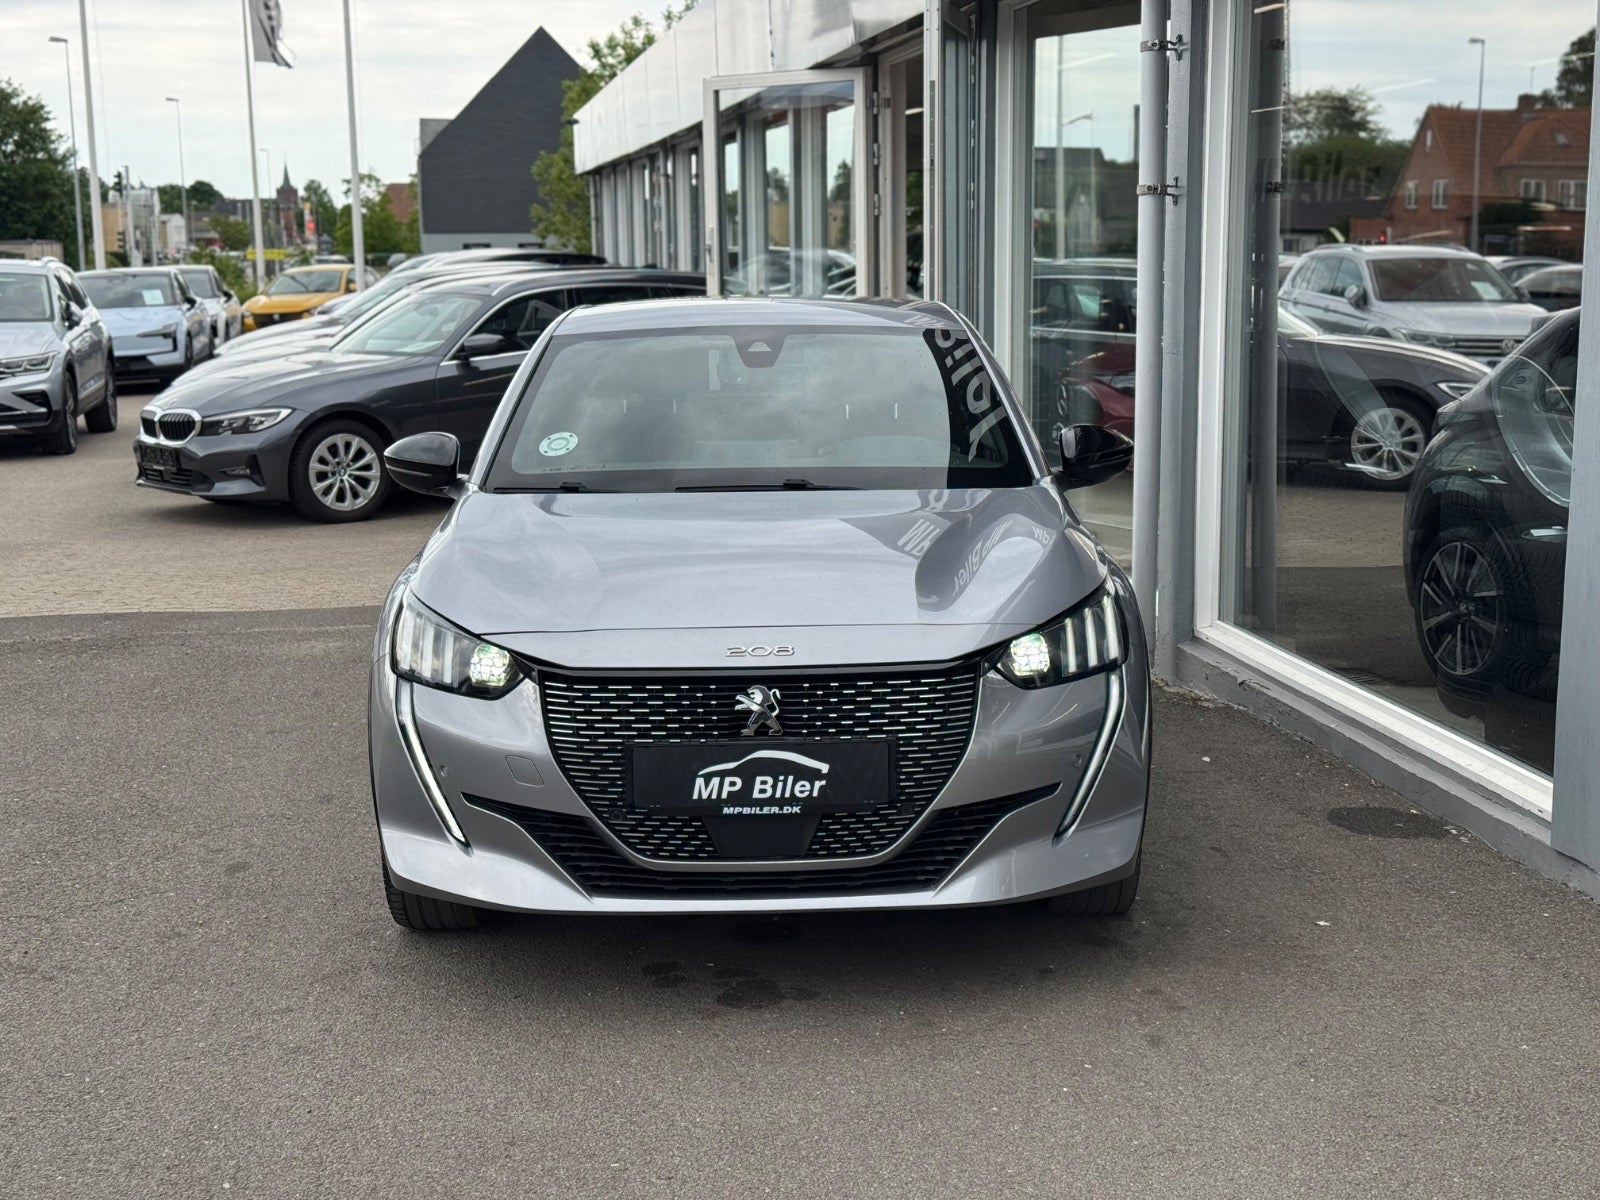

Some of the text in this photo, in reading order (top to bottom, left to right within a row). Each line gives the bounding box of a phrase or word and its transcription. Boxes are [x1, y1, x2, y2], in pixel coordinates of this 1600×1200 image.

[725, 645, 796, 658] 208
[692, 775, 827, 800] MP Biler
[722, 805, 802, 815] MPBILER.DK
